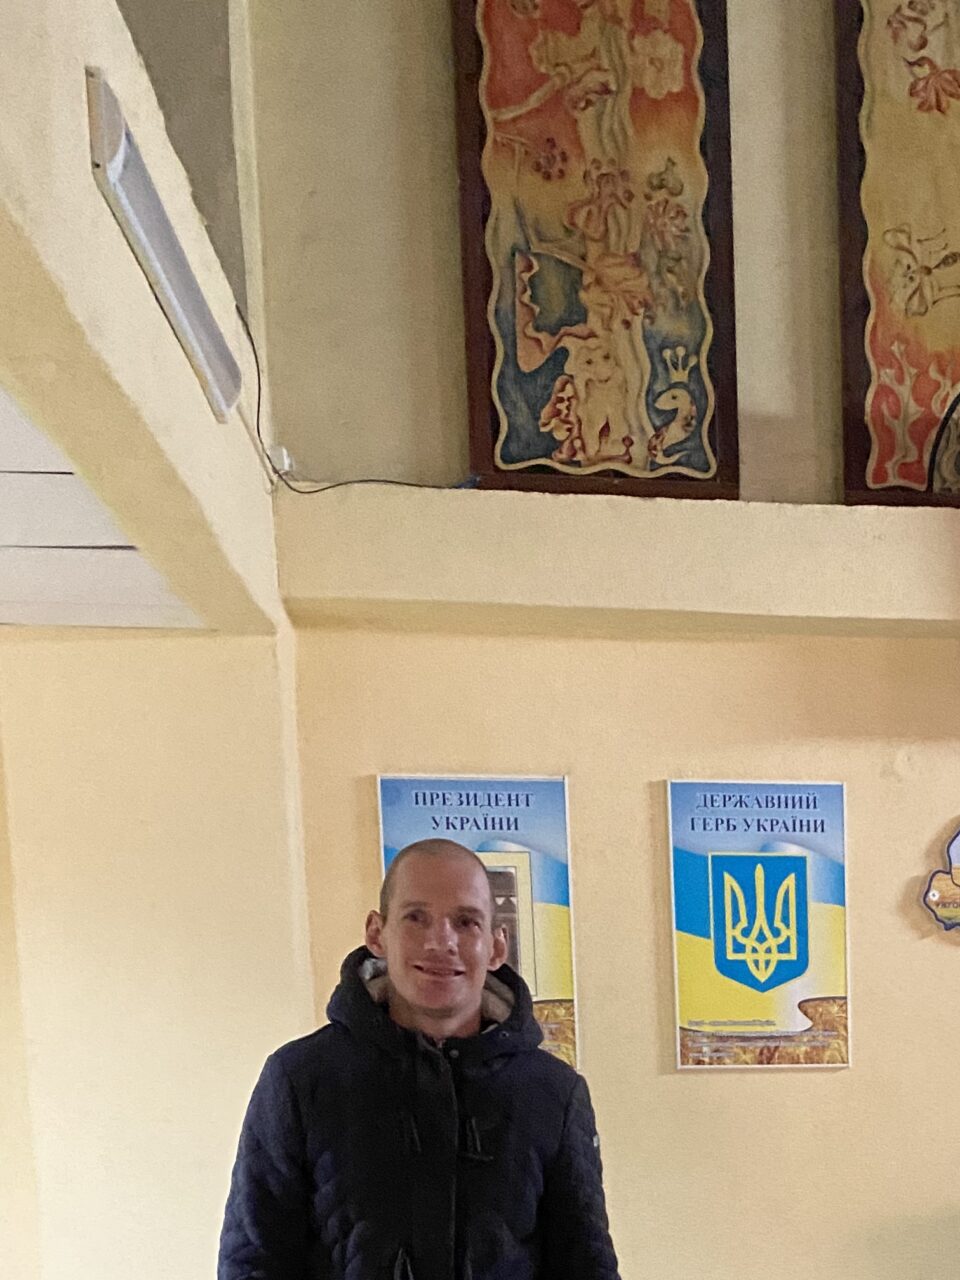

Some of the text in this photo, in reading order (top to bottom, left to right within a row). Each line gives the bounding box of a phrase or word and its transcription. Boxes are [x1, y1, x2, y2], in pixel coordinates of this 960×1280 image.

[413, 790, 535, 809] ПРЕЗИДЕНТ
[696, 790, 819, 810] ДЕРЖАВНИЙ
[431, 812, 520, 832] УКРАЇНИ
[689, 814, 826, 834] ГЕРБ УКРАЇНИ
